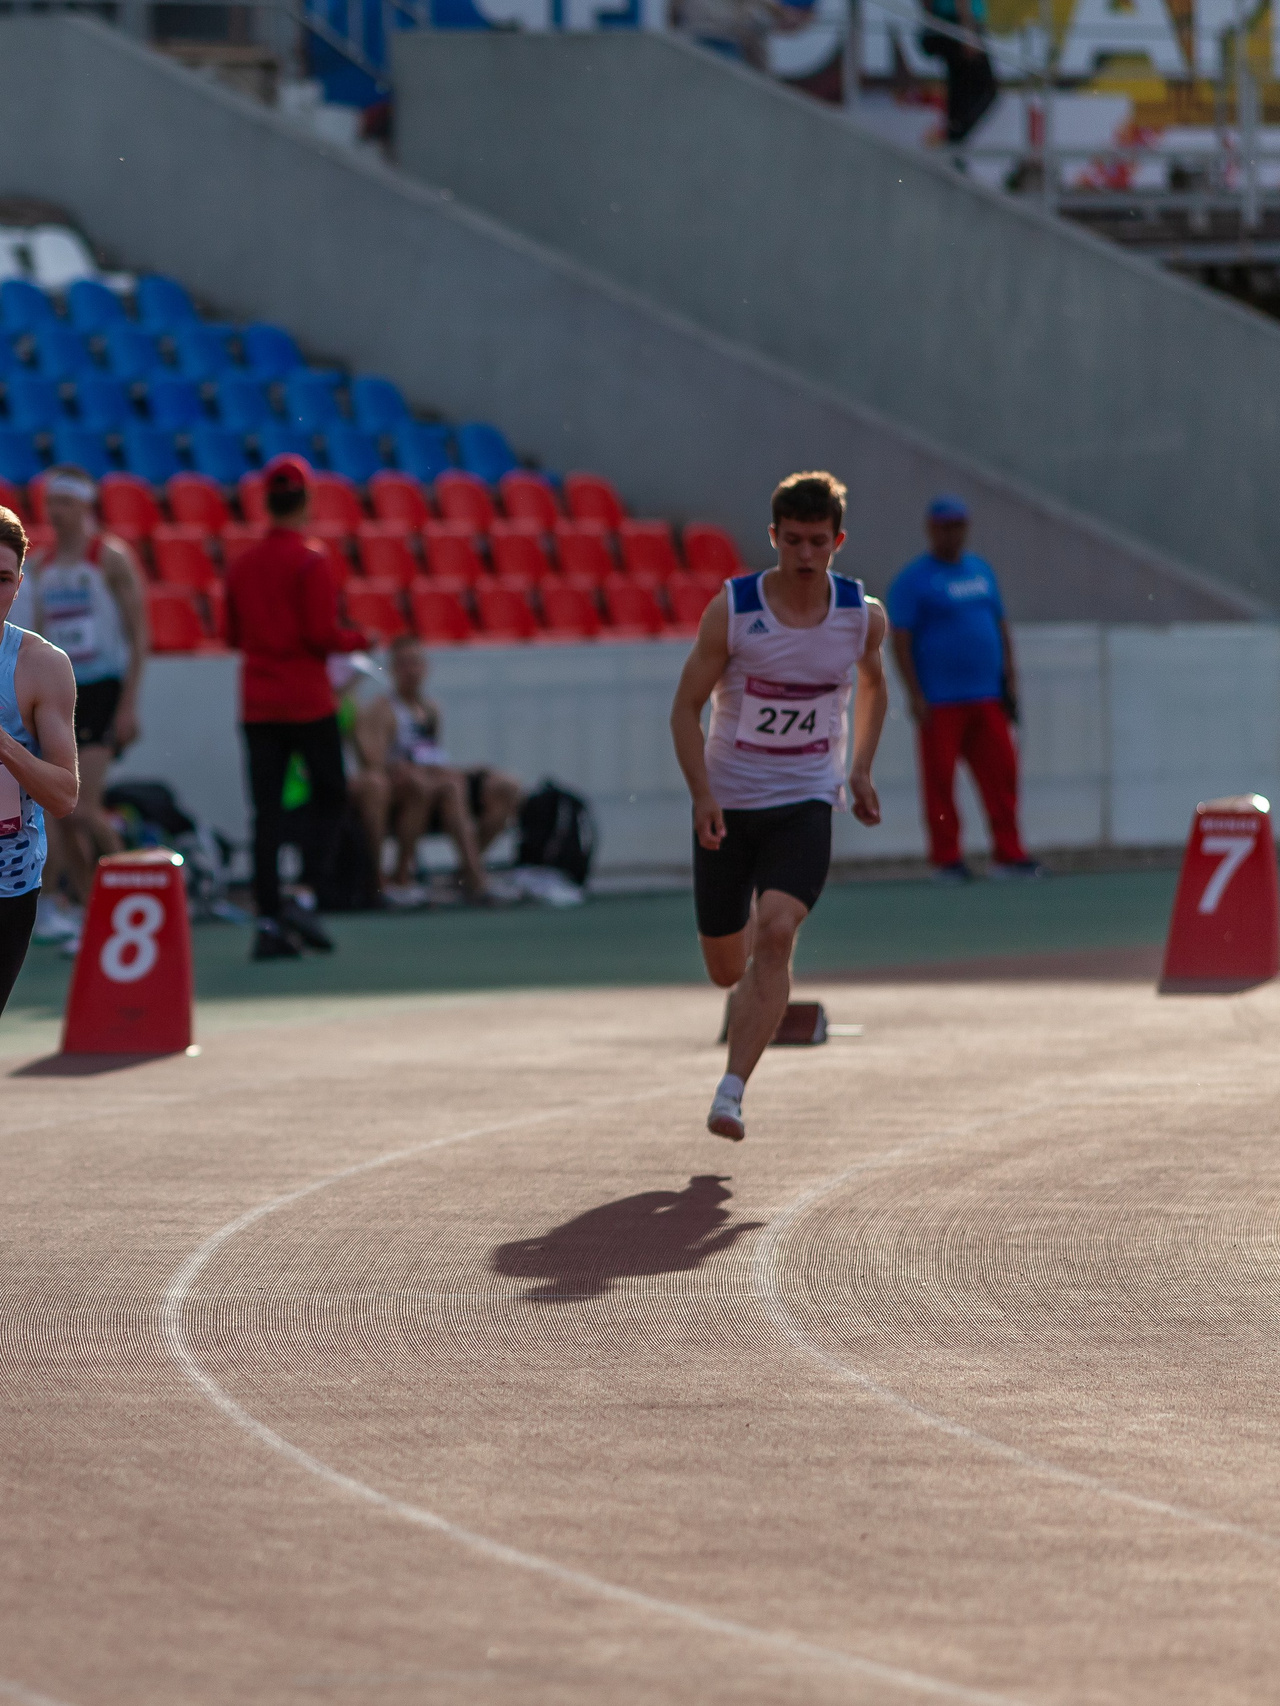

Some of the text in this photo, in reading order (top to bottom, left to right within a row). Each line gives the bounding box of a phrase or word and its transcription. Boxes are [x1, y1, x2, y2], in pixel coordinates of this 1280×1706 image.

[755, 706, 817, 735] 274
[1198, 836, 1256, 914] 7
[99, 892, 166, 984] 8
